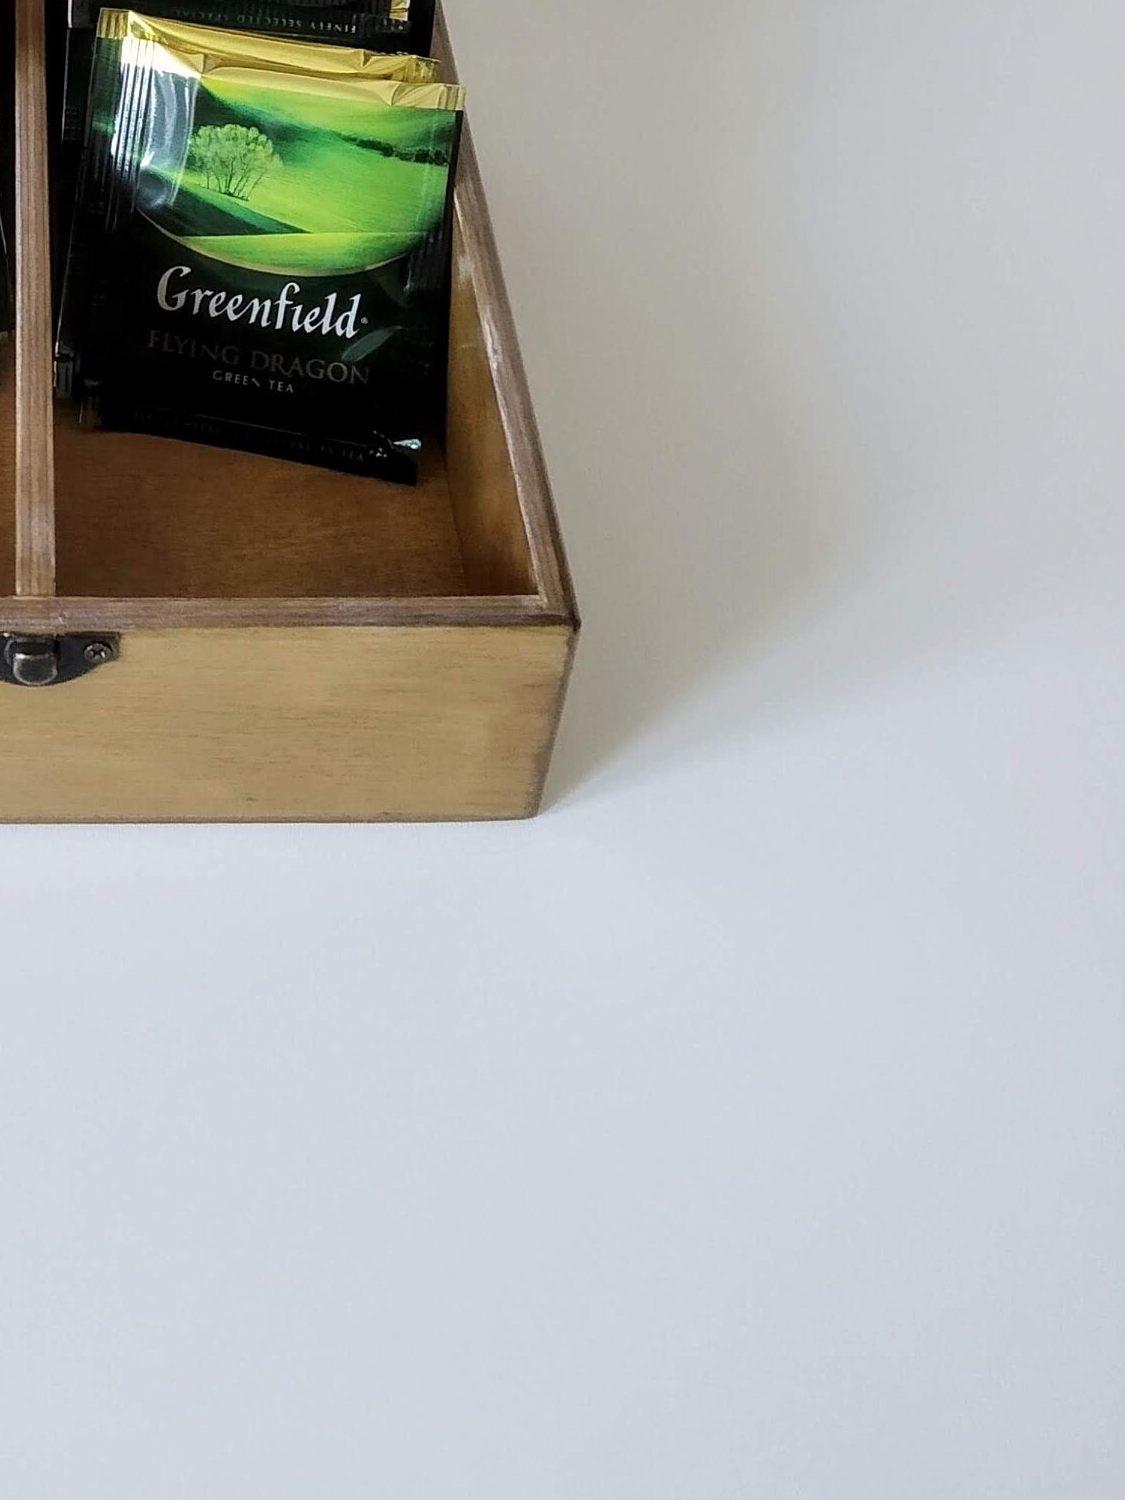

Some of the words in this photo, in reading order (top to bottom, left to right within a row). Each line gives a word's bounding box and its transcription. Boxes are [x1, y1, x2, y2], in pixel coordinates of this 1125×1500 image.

[236, 13, 303, 29] SELECTED
[308, 20, 357, 35] FINELY
[155, 264, 363, 340] Greenfield
[146, 327, 242, 366] FLYING
[249, 348, 372, 386] DRAGON
[211, 368, 261, 388] GREEN
[267, 379, 295, 395] TEA
